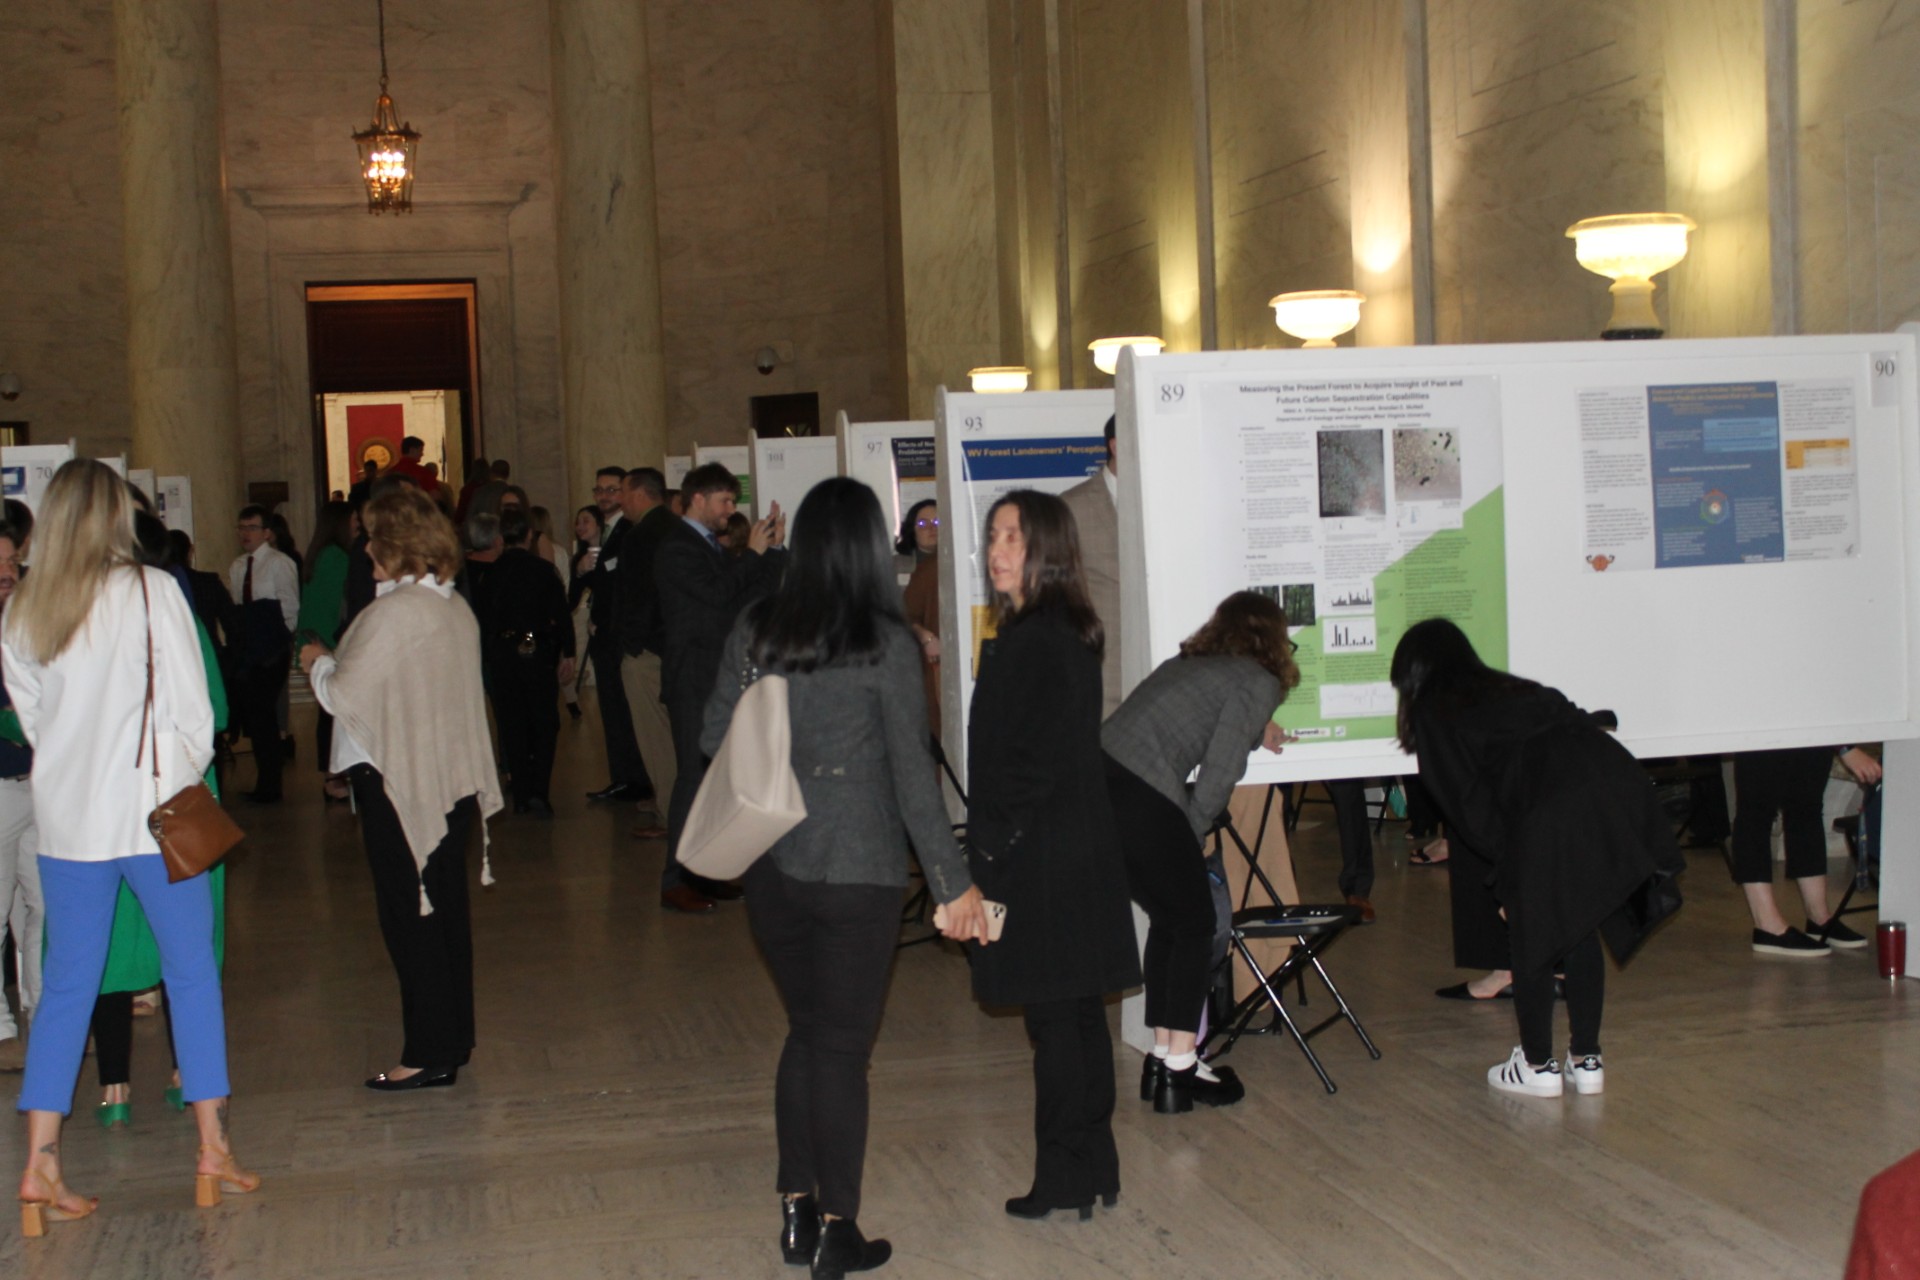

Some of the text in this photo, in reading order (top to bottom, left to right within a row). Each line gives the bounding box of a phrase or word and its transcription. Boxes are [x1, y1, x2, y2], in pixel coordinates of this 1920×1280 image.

[1874, 359, 1895, 378] 90
[1160, 382, 1184, 402] 89
[1239, 384, 1280, 393] Measuring
[1282, 383, 1294, 391] the
[1296, 383, 1326, 391] Present
[1327, 382, 1352, 390] Forest
[1363, 382, 1392, 390] Acquire
[1393, 380, 1419, 389] Insight
[1430, 379, 1447, 387] Past
[1448, 379, 1463, 387] and
[1275, 392, 1430, 404] Future Carbon Sequestration Capabilities
[964, 416, 983, 432] 93
[867, 442, 883, 456] 97
[967, 448, 983, 457] WV
[983, 447, 1011, 457] Forest
[1066, 444, 1107, 454] Perceptio
[36, 466, 53, 479] 70
